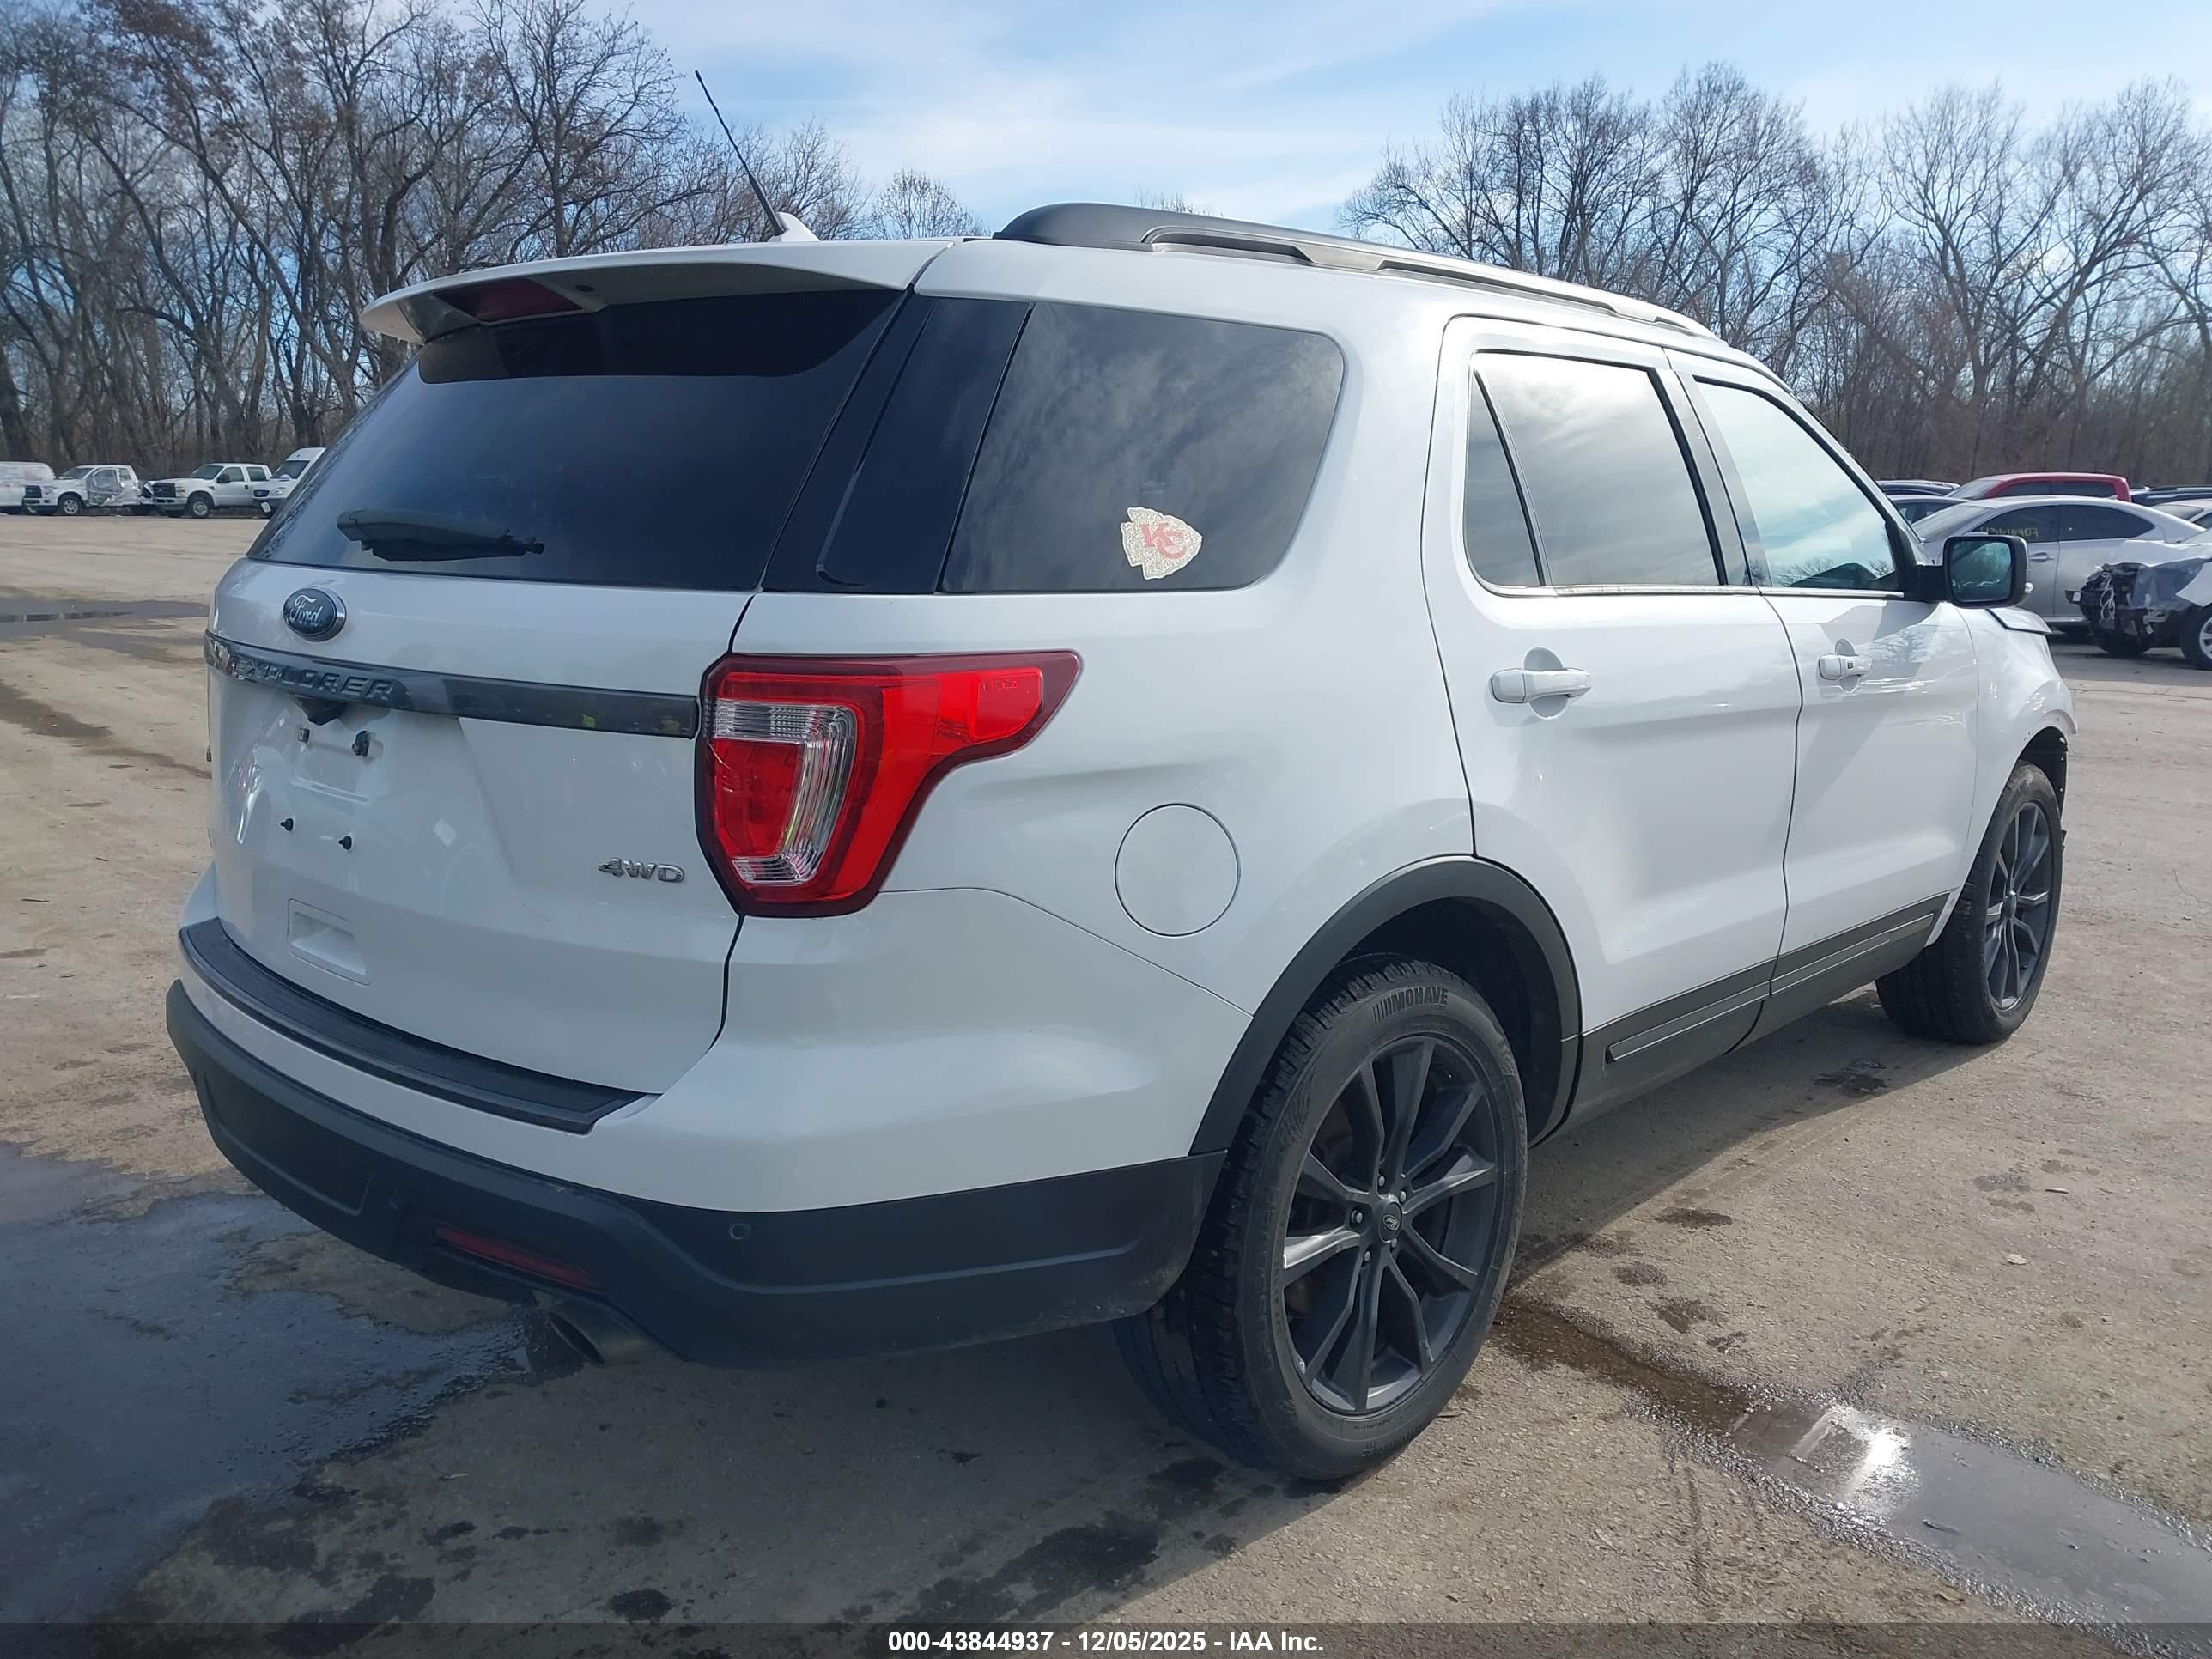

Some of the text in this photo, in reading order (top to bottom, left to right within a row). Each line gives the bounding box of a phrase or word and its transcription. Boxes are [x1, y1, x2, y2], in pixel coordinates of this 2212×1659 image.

[1140, 521, 1188, 560] KC
[289, 594, 324, 627] Ford
[228, 652, 394, 702] EXPLORER
[598, 858, 685, 883] 4WD
[1390, 987, 1449, 1013] MOHAVE
